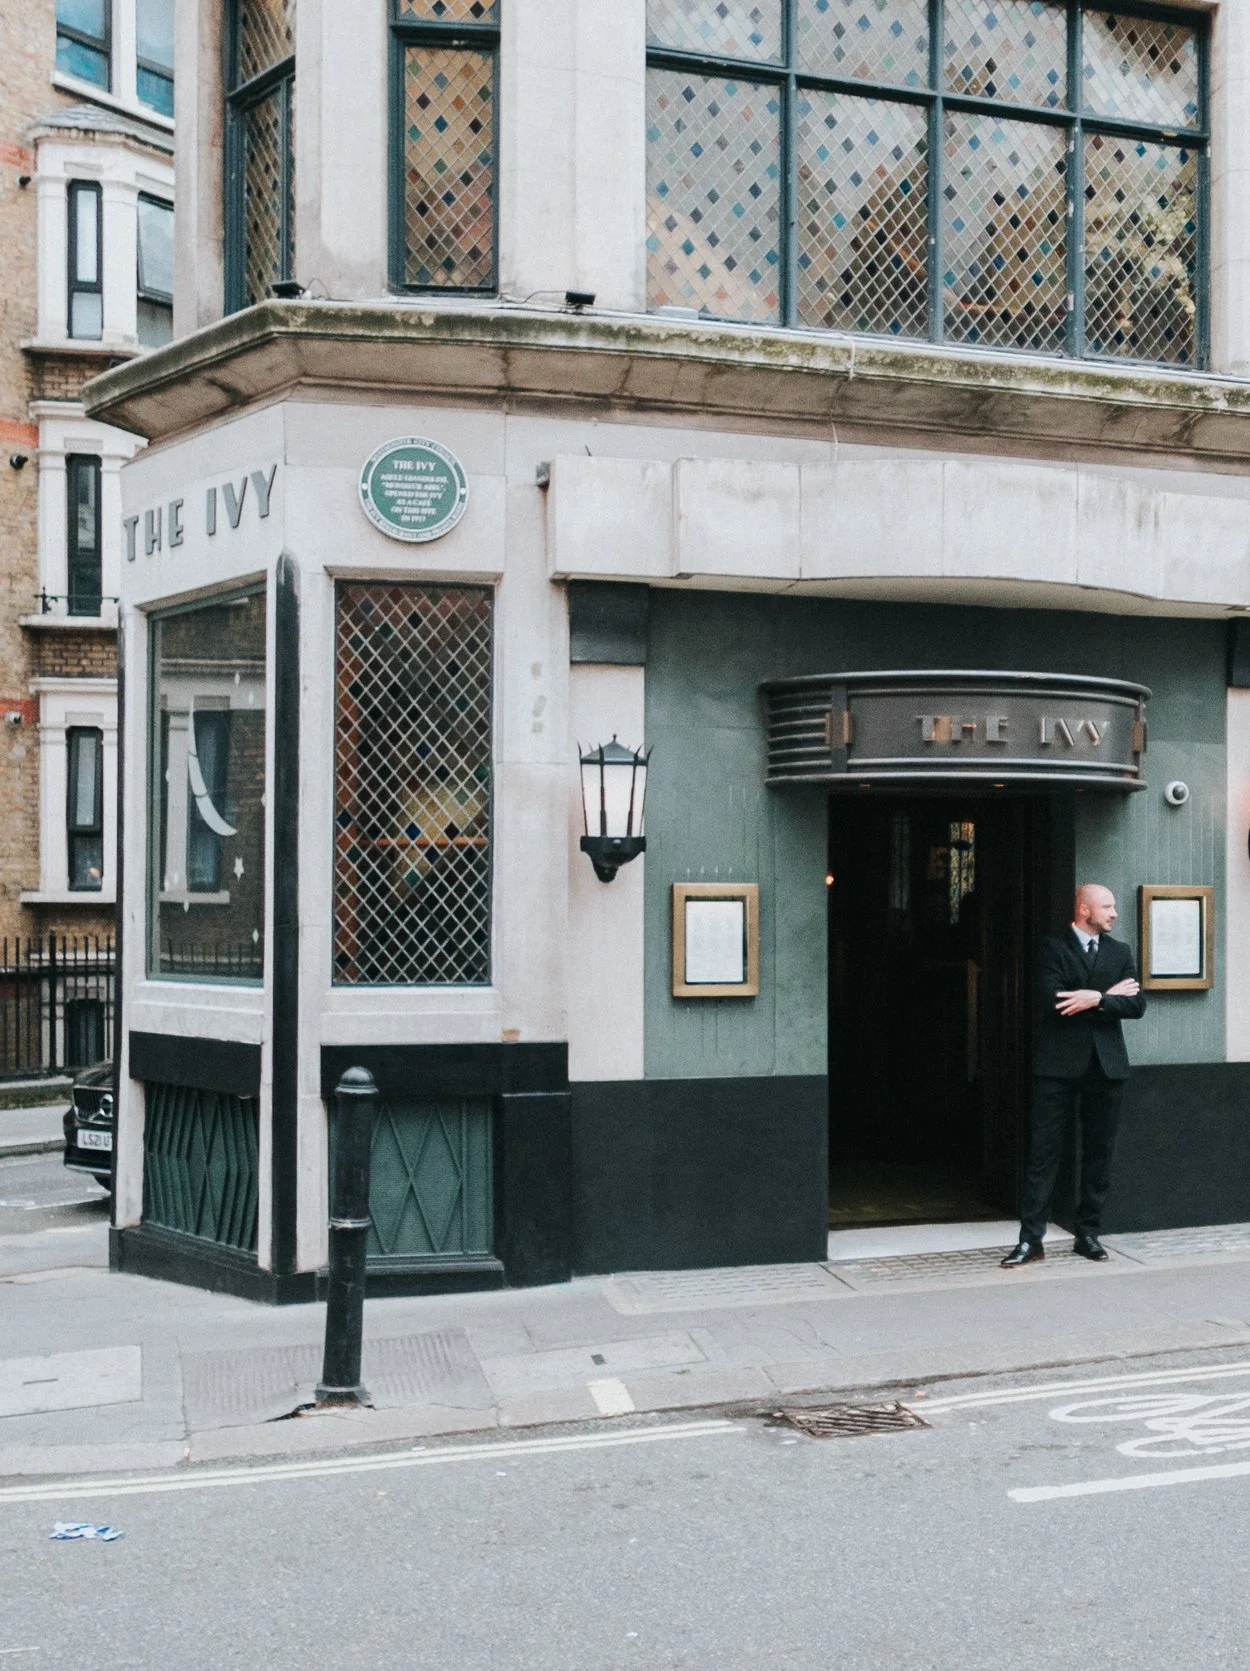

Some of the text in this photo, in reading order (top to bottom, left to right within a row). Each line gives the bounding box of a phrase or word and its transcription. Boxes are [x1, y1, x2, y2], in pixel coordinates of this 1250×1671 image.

[393, 460, 436, 472] THE IVY
[123, 464, 277, 562] THE IVY
[915, 714, 1111, 747] THE IVY
